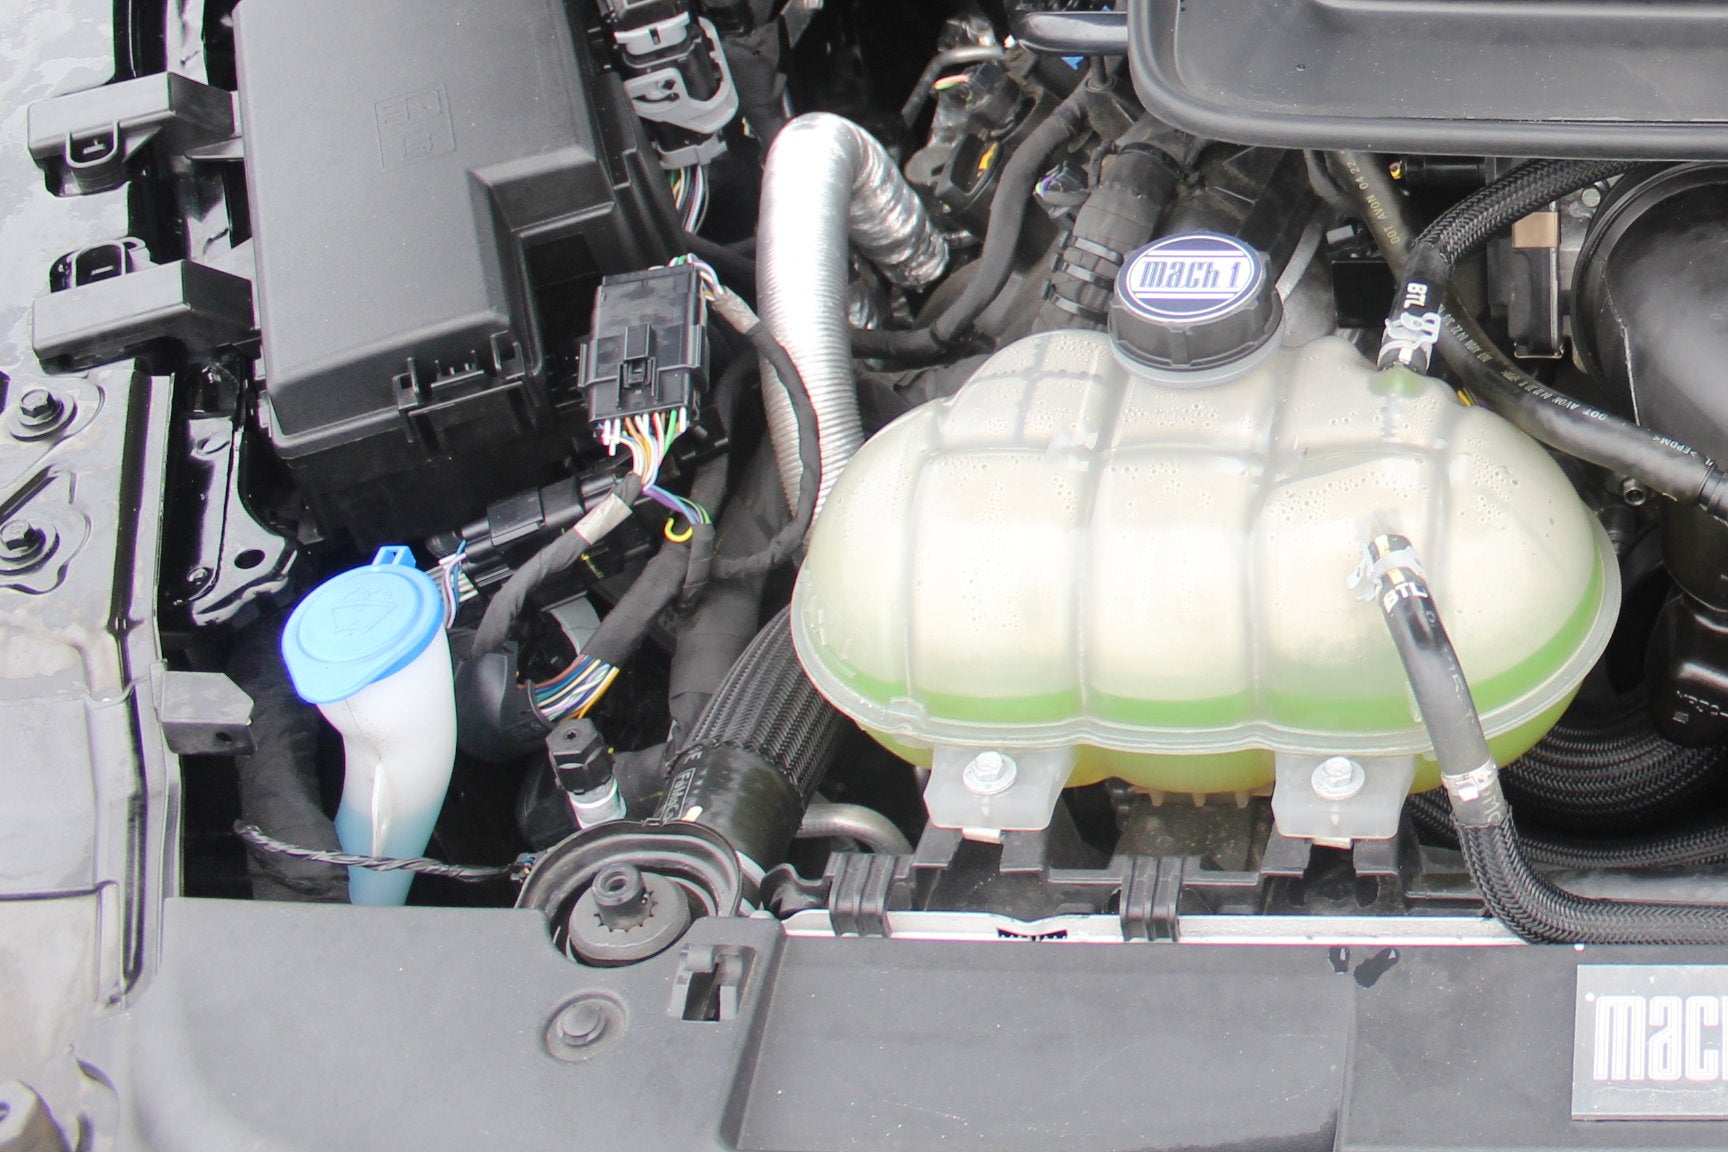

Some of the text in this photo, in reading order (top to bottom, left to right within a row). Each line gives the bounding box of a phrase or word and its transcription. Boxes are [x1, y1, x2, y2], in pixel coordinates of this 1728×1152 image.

[1346, 160, 1401, 245] DOT AVON 04 22
[1226, 261, 1241, 288] 1
[1582, 407, 1608, 421] DOT
[1652, 435, 1698, 458] >EPDM<
